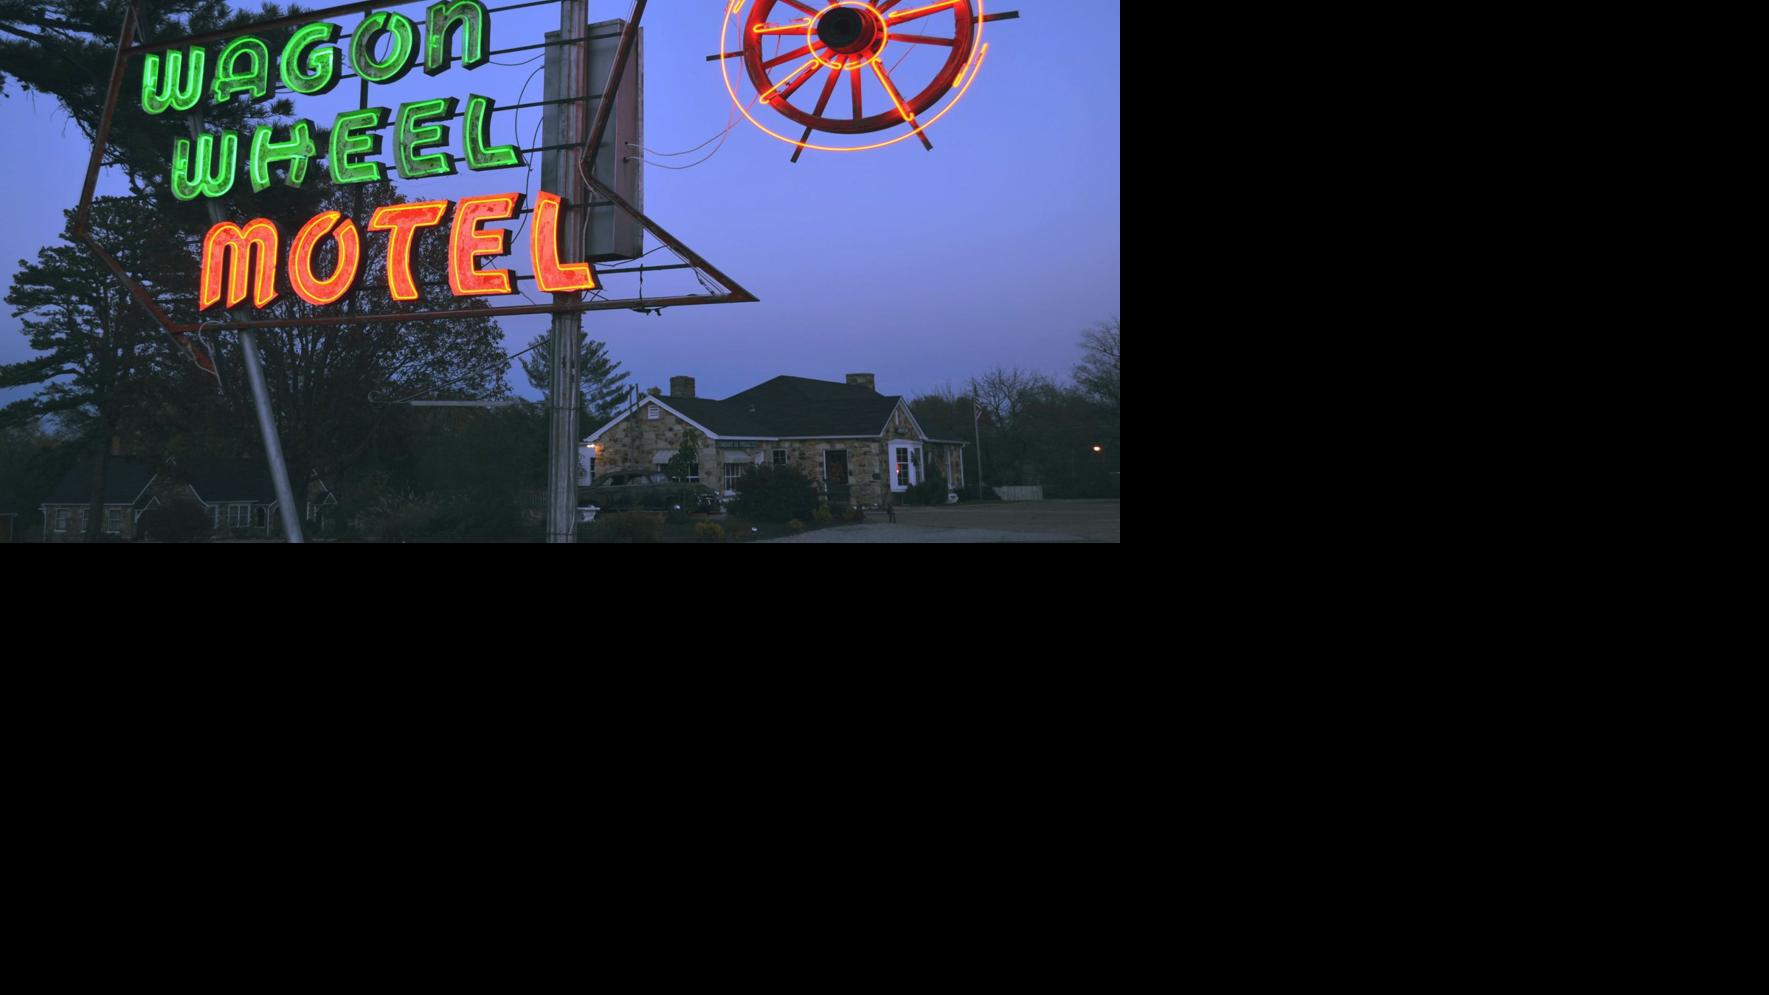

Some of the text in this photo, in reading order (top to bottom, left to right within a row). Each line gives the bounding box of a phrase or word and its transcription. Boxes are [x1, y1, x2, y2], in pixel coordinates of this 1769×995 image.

[142, 0, 490, 115] WAGON
[171, 94, 524, 200] WHEEL
[200, 191, 598, 310] MOTEL
